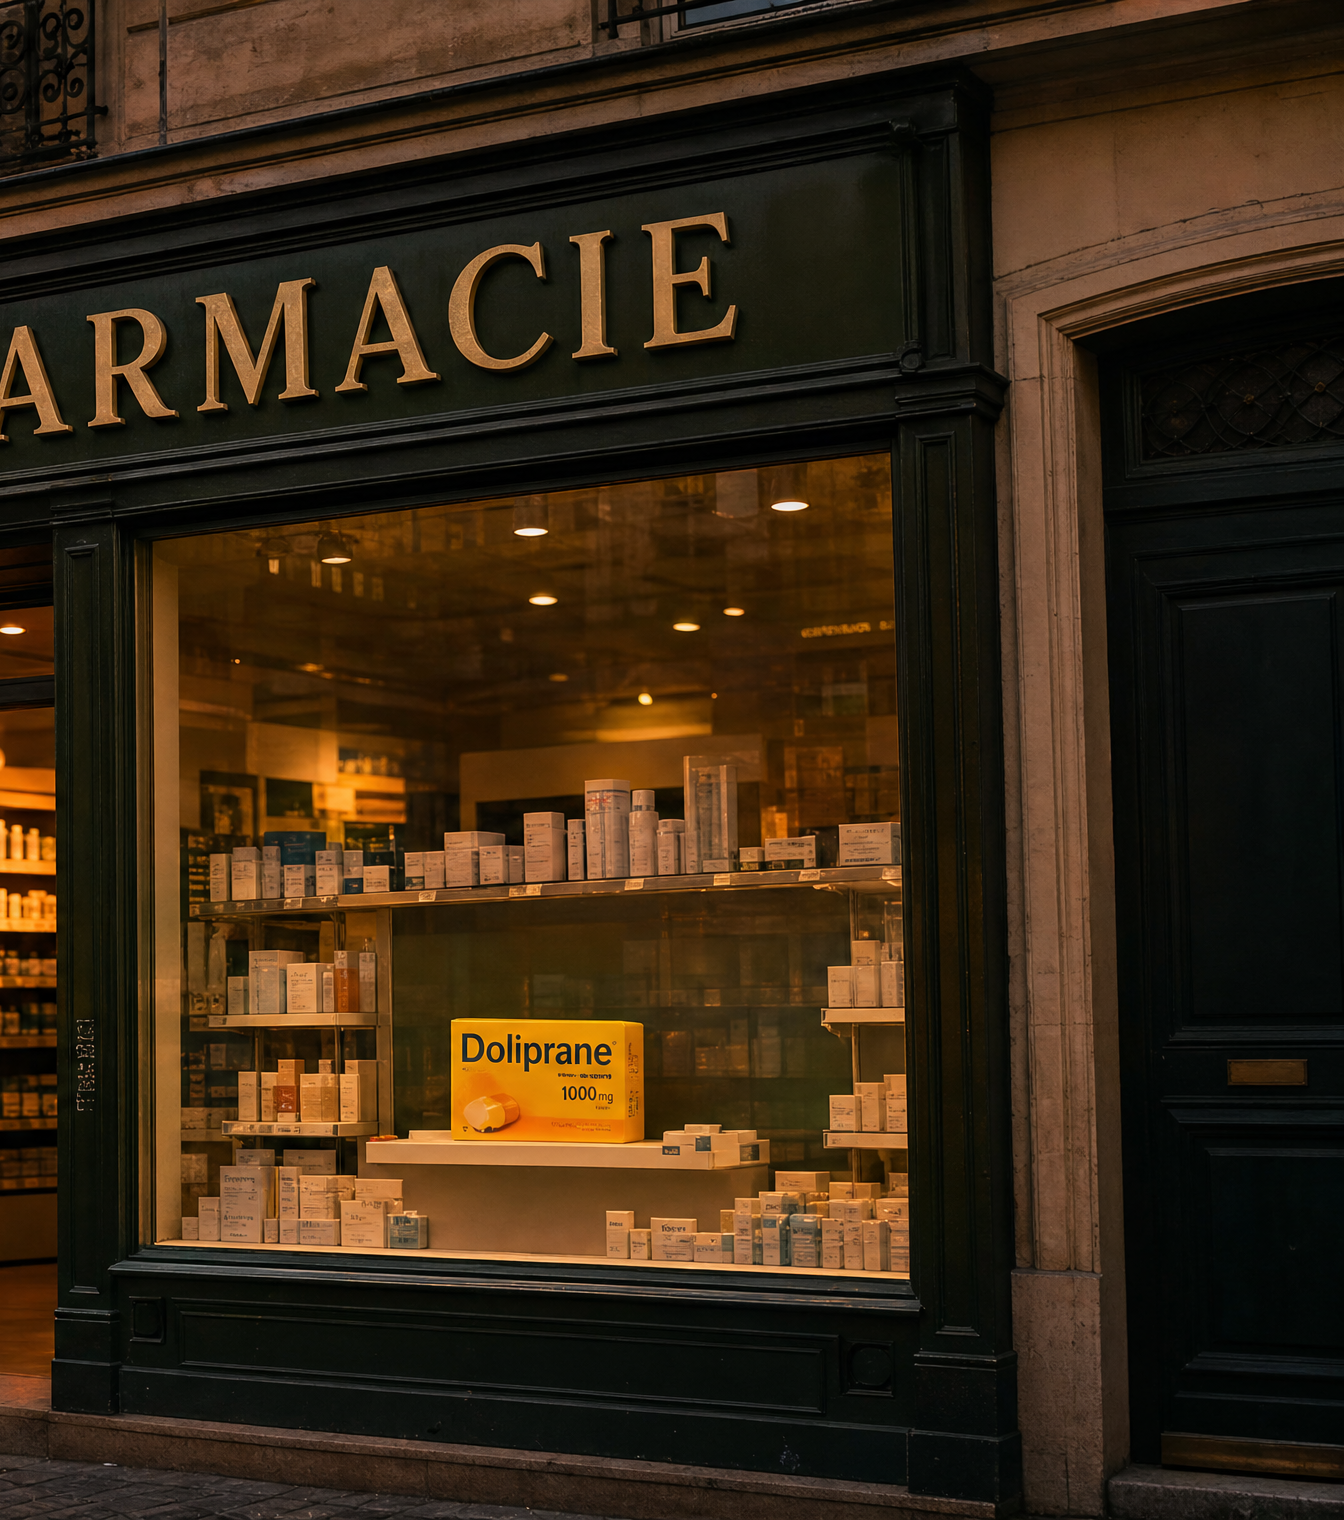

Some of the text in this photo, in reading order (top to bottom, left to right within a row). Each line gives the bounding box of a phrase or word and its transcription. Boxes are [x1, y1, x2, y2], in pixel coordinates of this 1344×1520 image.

[460, 1032, 613, 1072] Doliprane
[561, 1085, 614, 1105] 1000 mg
